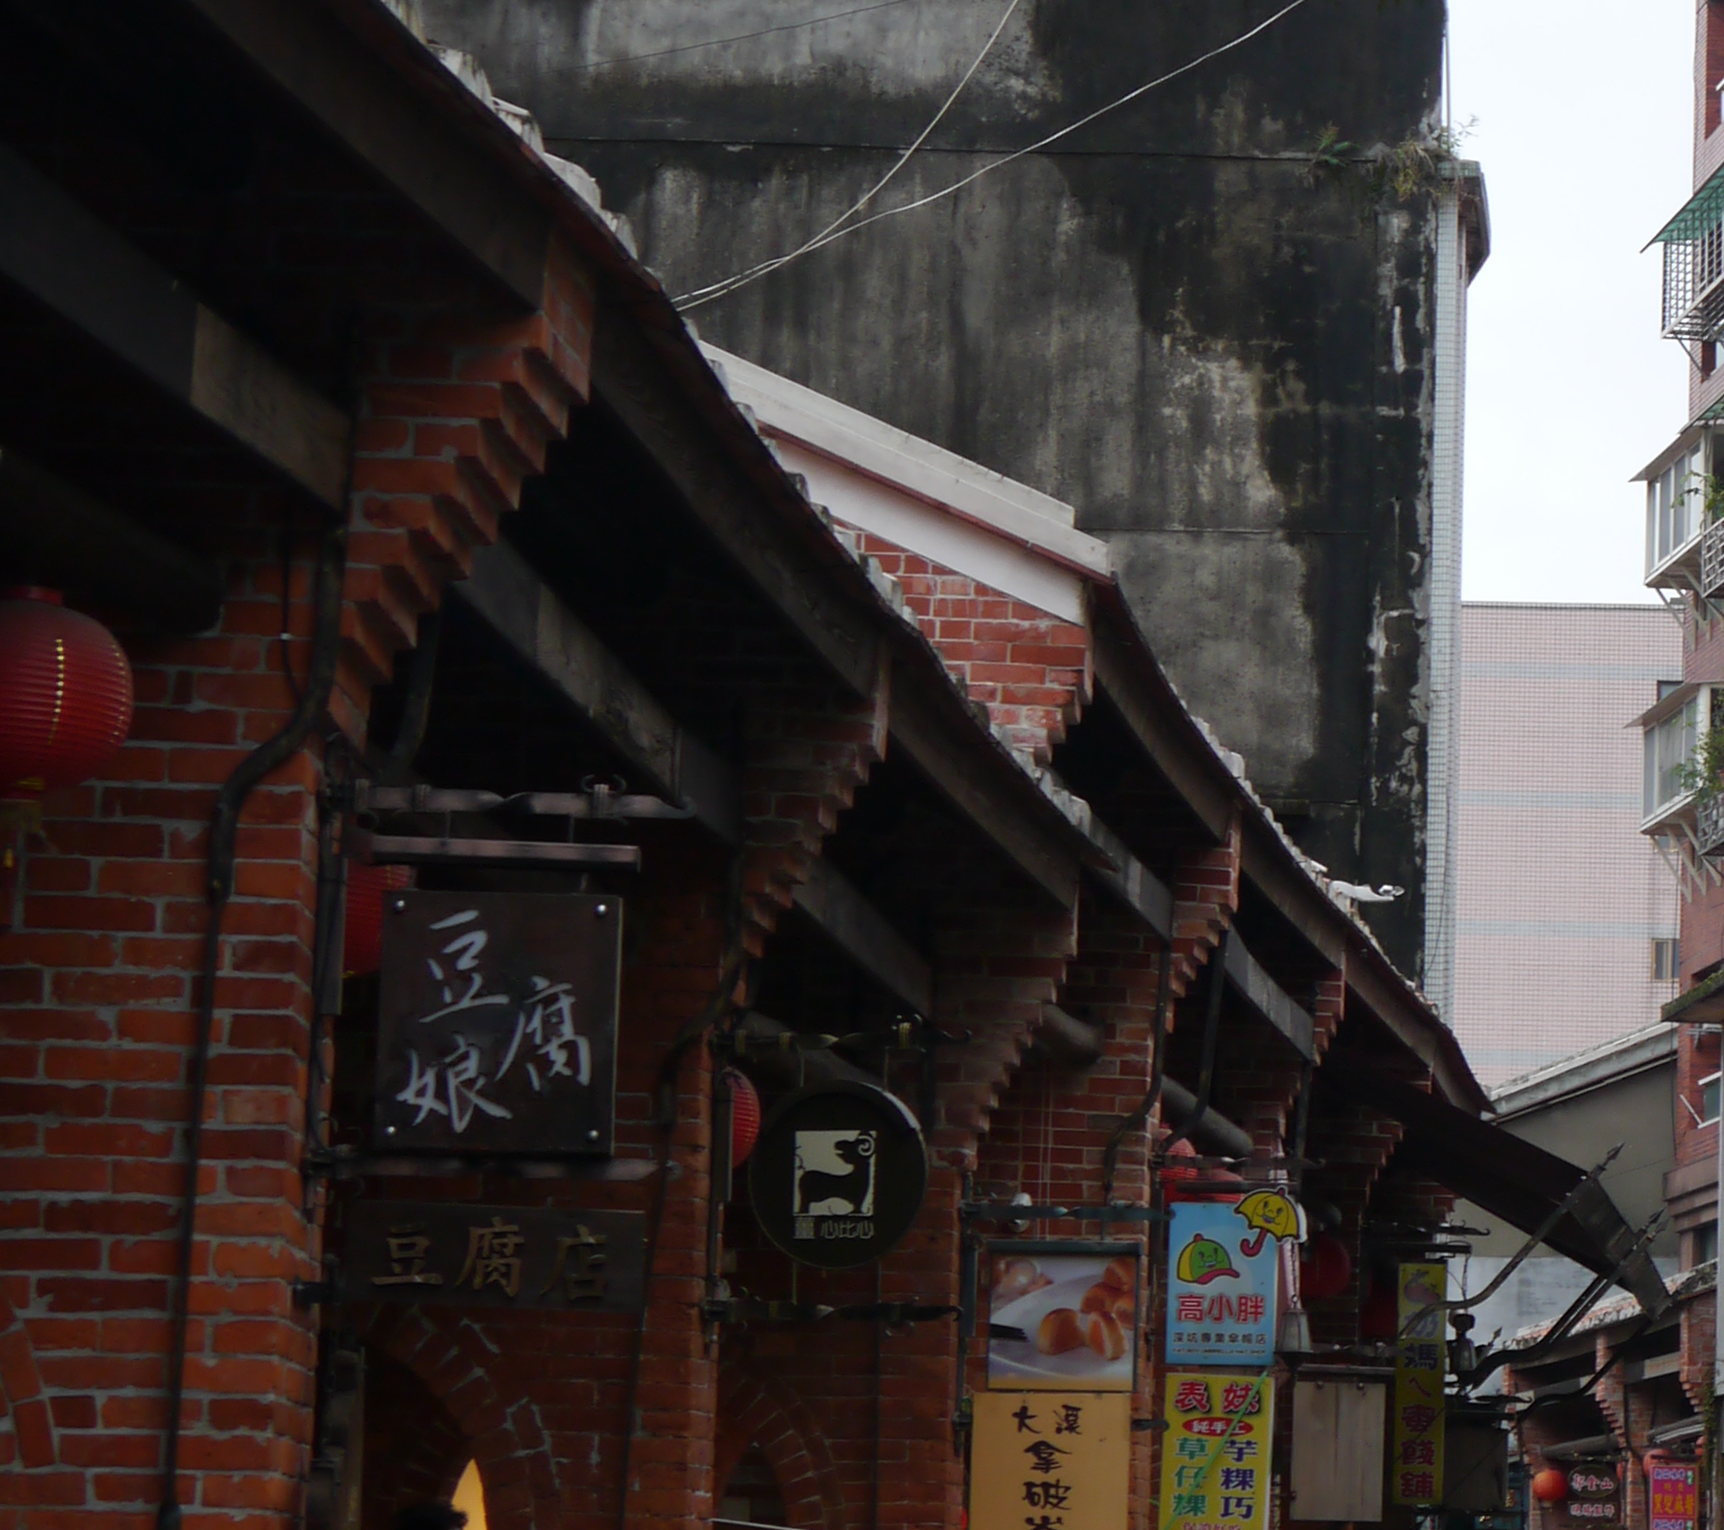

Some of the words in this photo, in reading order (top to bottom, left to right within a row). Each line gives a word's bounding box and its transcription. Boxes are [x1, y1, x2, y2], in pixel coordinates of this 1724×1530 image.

[396, 909, 592, 1134] 豆腐娘
[370, 1216, 608, 1301] 豆腐店
[1176, 1292, 1266, 1325] 高小胖
[1173, 1437, 1210, 1517] 草仔粿
[1219, 1438, 1259, 1519] 芋粿巧
